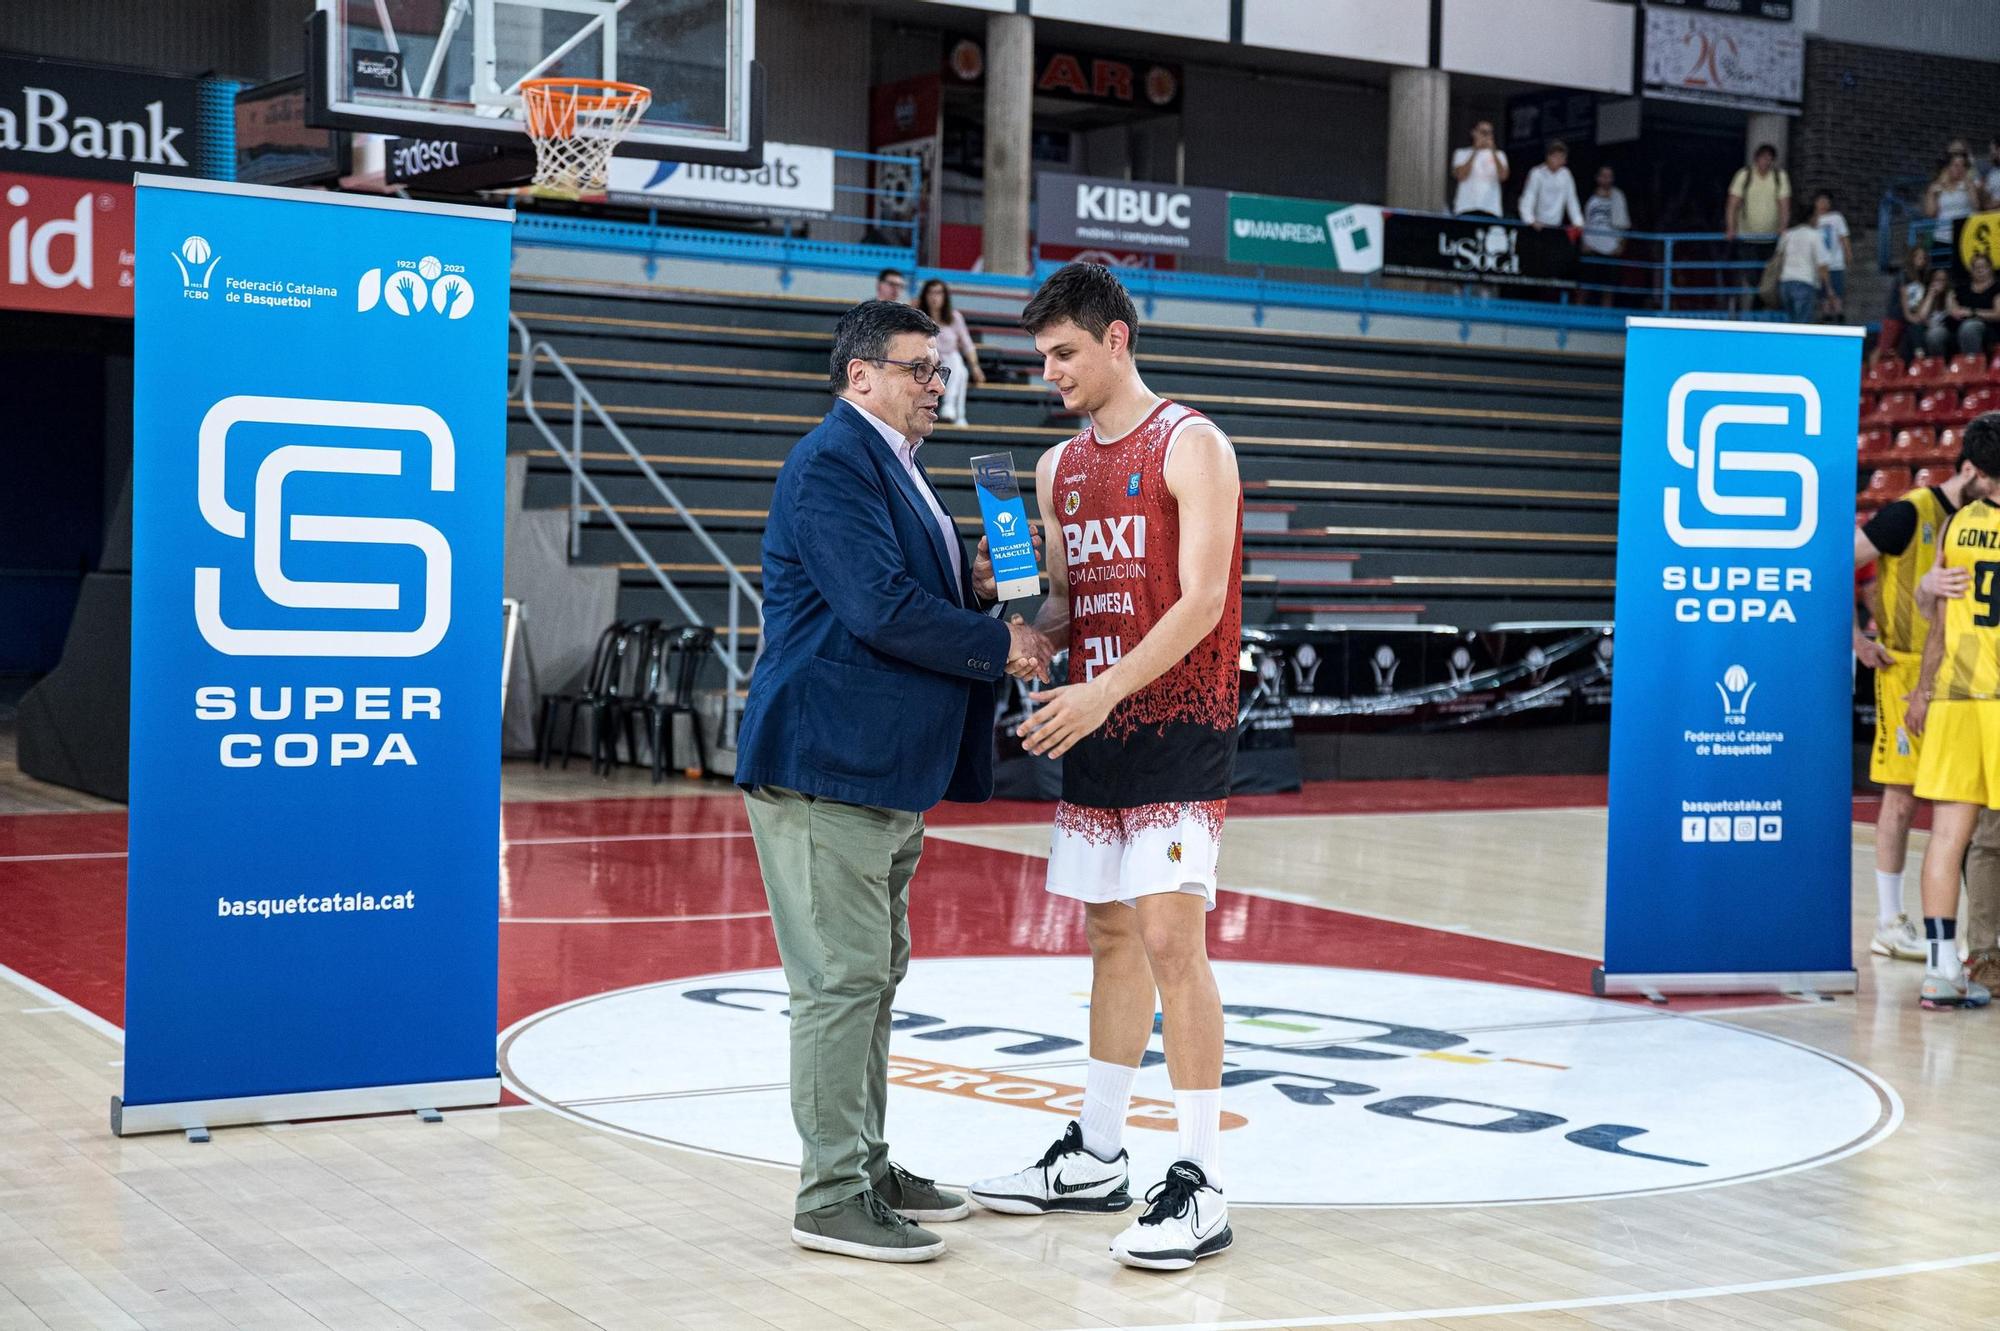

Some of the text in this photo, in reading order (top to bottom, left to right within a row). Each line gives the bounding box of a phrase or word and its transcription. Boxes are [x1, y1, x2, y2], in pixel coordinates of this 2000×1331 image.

[1039, 53, 1134, 100] AR
[0, 86, 189, 166] aBank
[1077, 184, 1191, 229] KIBUC
[397, 260, 416, 269] 1923
[444, 264, 465, 273] 2023
[184, 289, 209, 300] FCBQ
[226, 277, 338, 297] Federació Catalana
[225, 292, 312, 308] de Basquetbol
[1063, 514, 1146, 567] BAXI
[1957, 528, 2000, 546] GONZ
[994, 548, 1031, 560] MASCULÍ
[1662, 566, 1812, 592] SUPER
[1973, 560, 2000, 628] 9
[1675, 598, 1797, 623] COPA
[195, 686, 442, 720] SUPER
[1684, 730, 1784, 743] Federació Catalana
[219, 733, 418, 767] COPA
[1696, 744, 1772, 757] de Basquetbol
[1682, 799, 1782, 814] basquetcatala.cat
[217, 890, 415, 919] basquetcatala.cat
